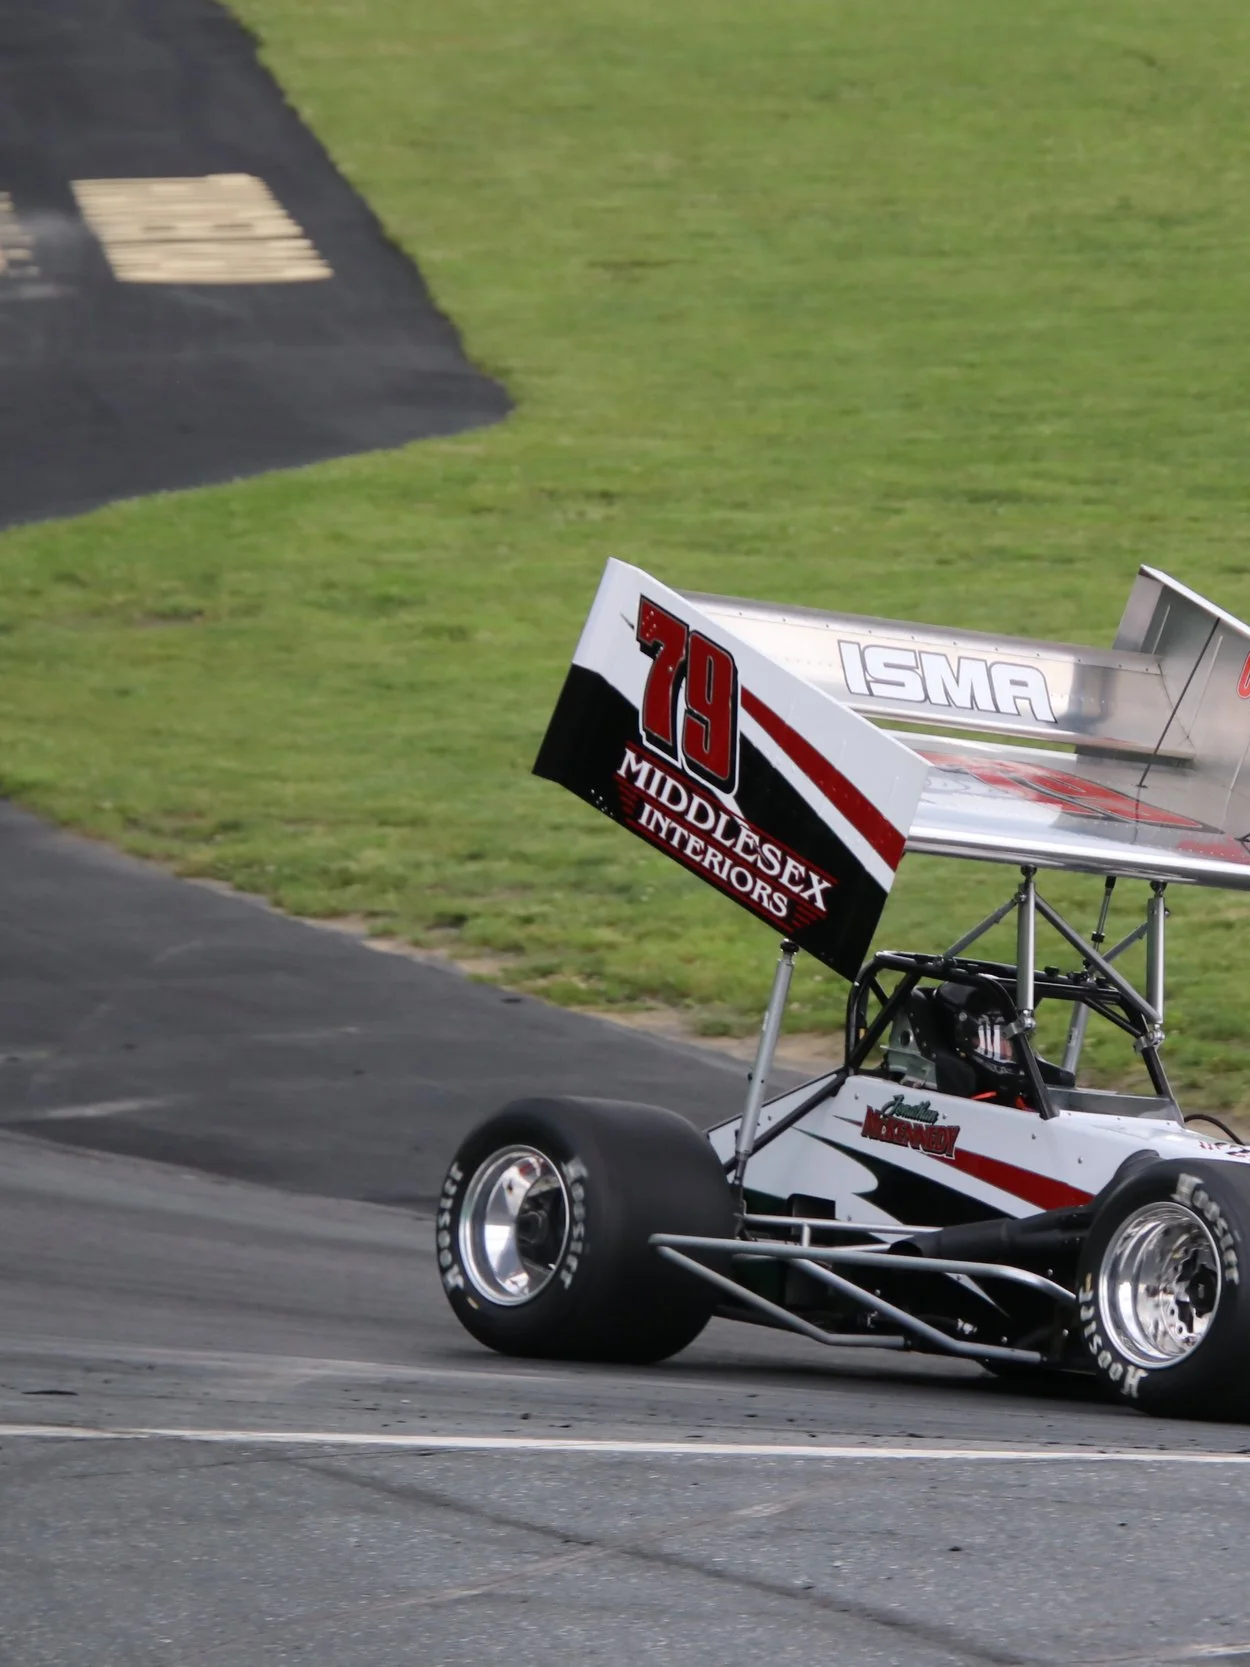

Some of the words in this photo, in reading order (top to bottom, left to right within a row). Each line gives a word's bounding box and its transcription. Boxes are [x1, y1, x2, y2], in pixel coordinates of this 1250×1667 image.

[636, 593, 740, 794] 79
[837, 639, 1058, 724] ISMA
[616, 748, 834, 911] MIDDLESEX
[638, 802, 789, 919] INTERIORS
